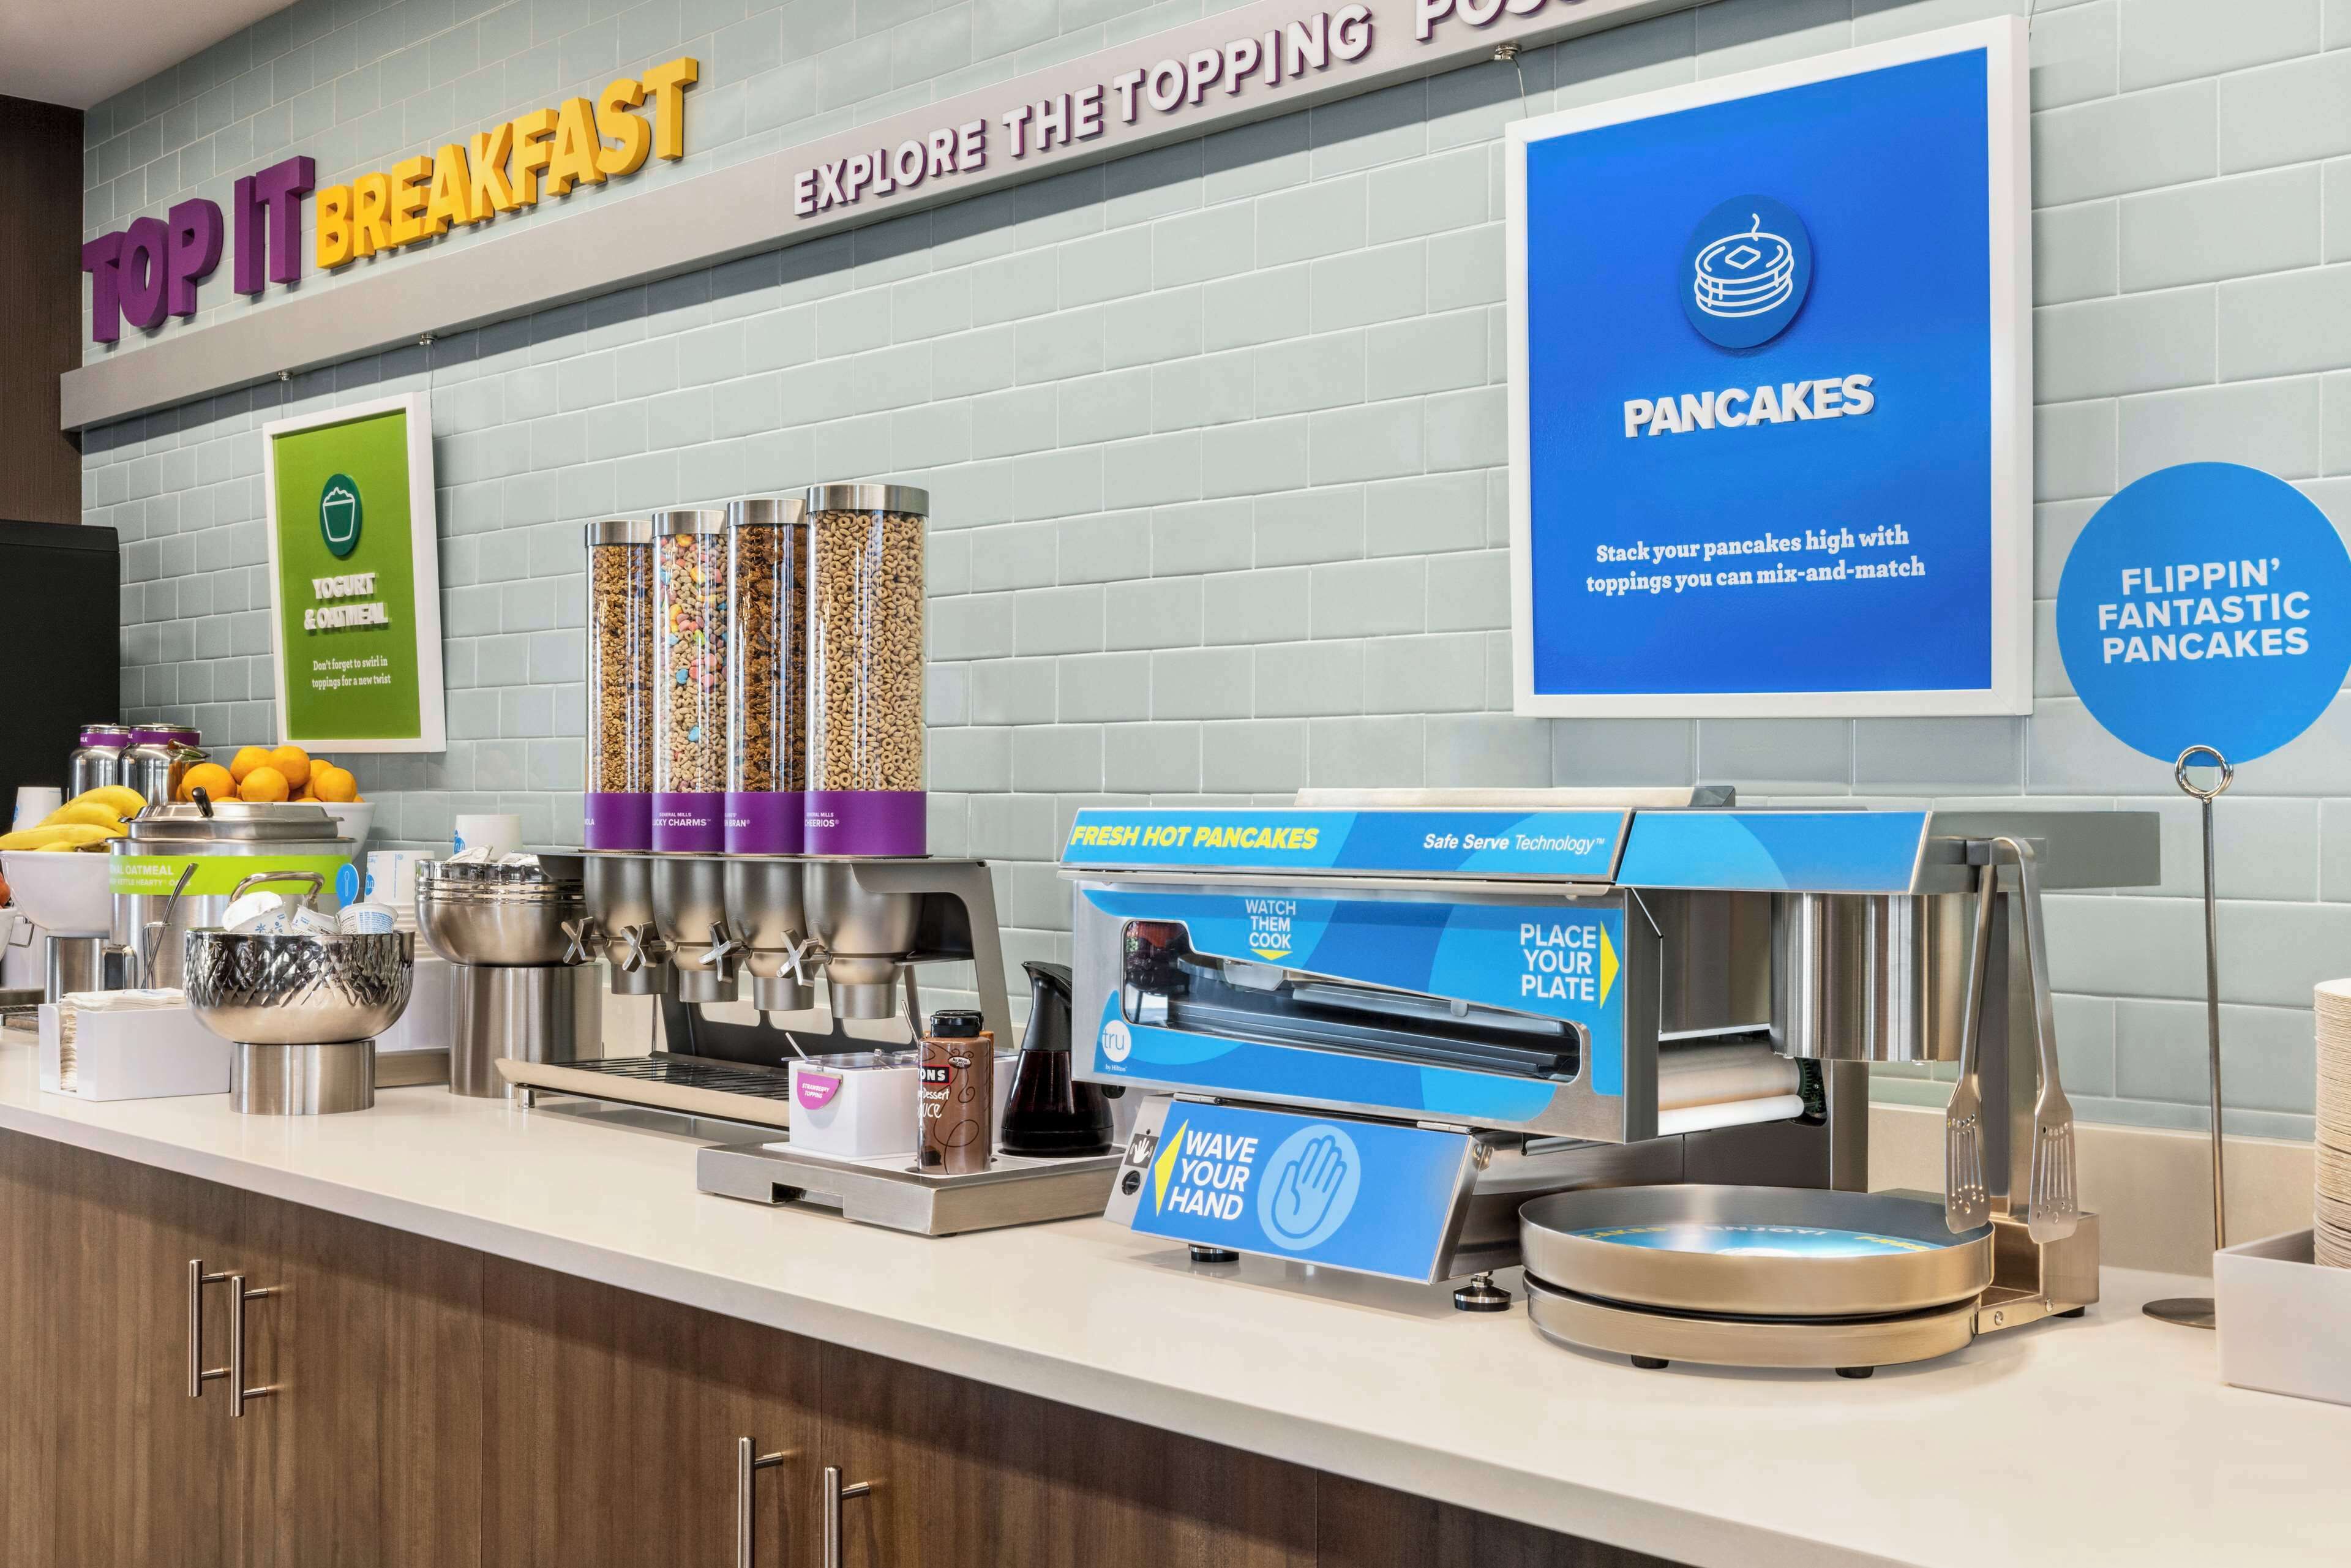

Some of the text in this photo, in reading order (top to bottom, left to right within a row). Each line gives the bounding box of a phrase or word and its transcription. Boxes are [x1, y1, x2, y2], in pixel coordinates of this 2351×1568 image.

[794, 119, 986, 216] EXPLORE
[1002, 84, 1103, 157] THE
[1112, 3, 1373, 123] TOPPING
[83, 56, 699, 343] TOP IT BREAKFAST
[1624, 374, 1875, 438] PANCAKES
[1596, 524, 1909, 565] Stack your pancakes high with
[312, 572, 376, 599] YOGURT
[1586, 555, 1925, 596] toppings you can mix-and-match
[2121, 557, 2280, 596] FLIPPIN’
[304, 602, 388, 631] & OATMEAL
[2098, 591, 2311, 631] FANTASTIC
[2103, 627, 2309, 664] PANCAKES
[313, 655, 388, 672] Don't forget to swirl in
[312, 676, 341, 690] toppings
[342, 675, 353, 686] for
[359, 677, 373, 685] new
[373, 673, 391, 685] twist
[1070, 826, 1319, 849] FRESH HOT PANCAKES
[1423, 833, 1458, 849] Safe
[1463, 834, 1509, 850] Serve
[126, 865, 174, 876] OATMEAL
[1245, 899, 1296, 915] WATCH
[1250, 915, 1291, 932] THEM
[1520, 923, 1597, 948] PLACE
[1249, 932, 1292, 949] COOK
[1523, 949, 1592, 975] YOUR
[1521, 974, 1594, 1001] PLATE
[1103, 1029, 1125, 1051] tru
[801, 1082, 830, 1093] STRAWBERRY
[918, 1068, 946, 1081] ONS
[804, 1090, 823, 1099] TOPPING
[923, 1087, 950, 1100] Dessert
[1186, 1130, 1259, 1163] WAVE
[1181, 1158, 1250, 1192] YOUR
[1168, 1186, 1243, 1220] HAND
